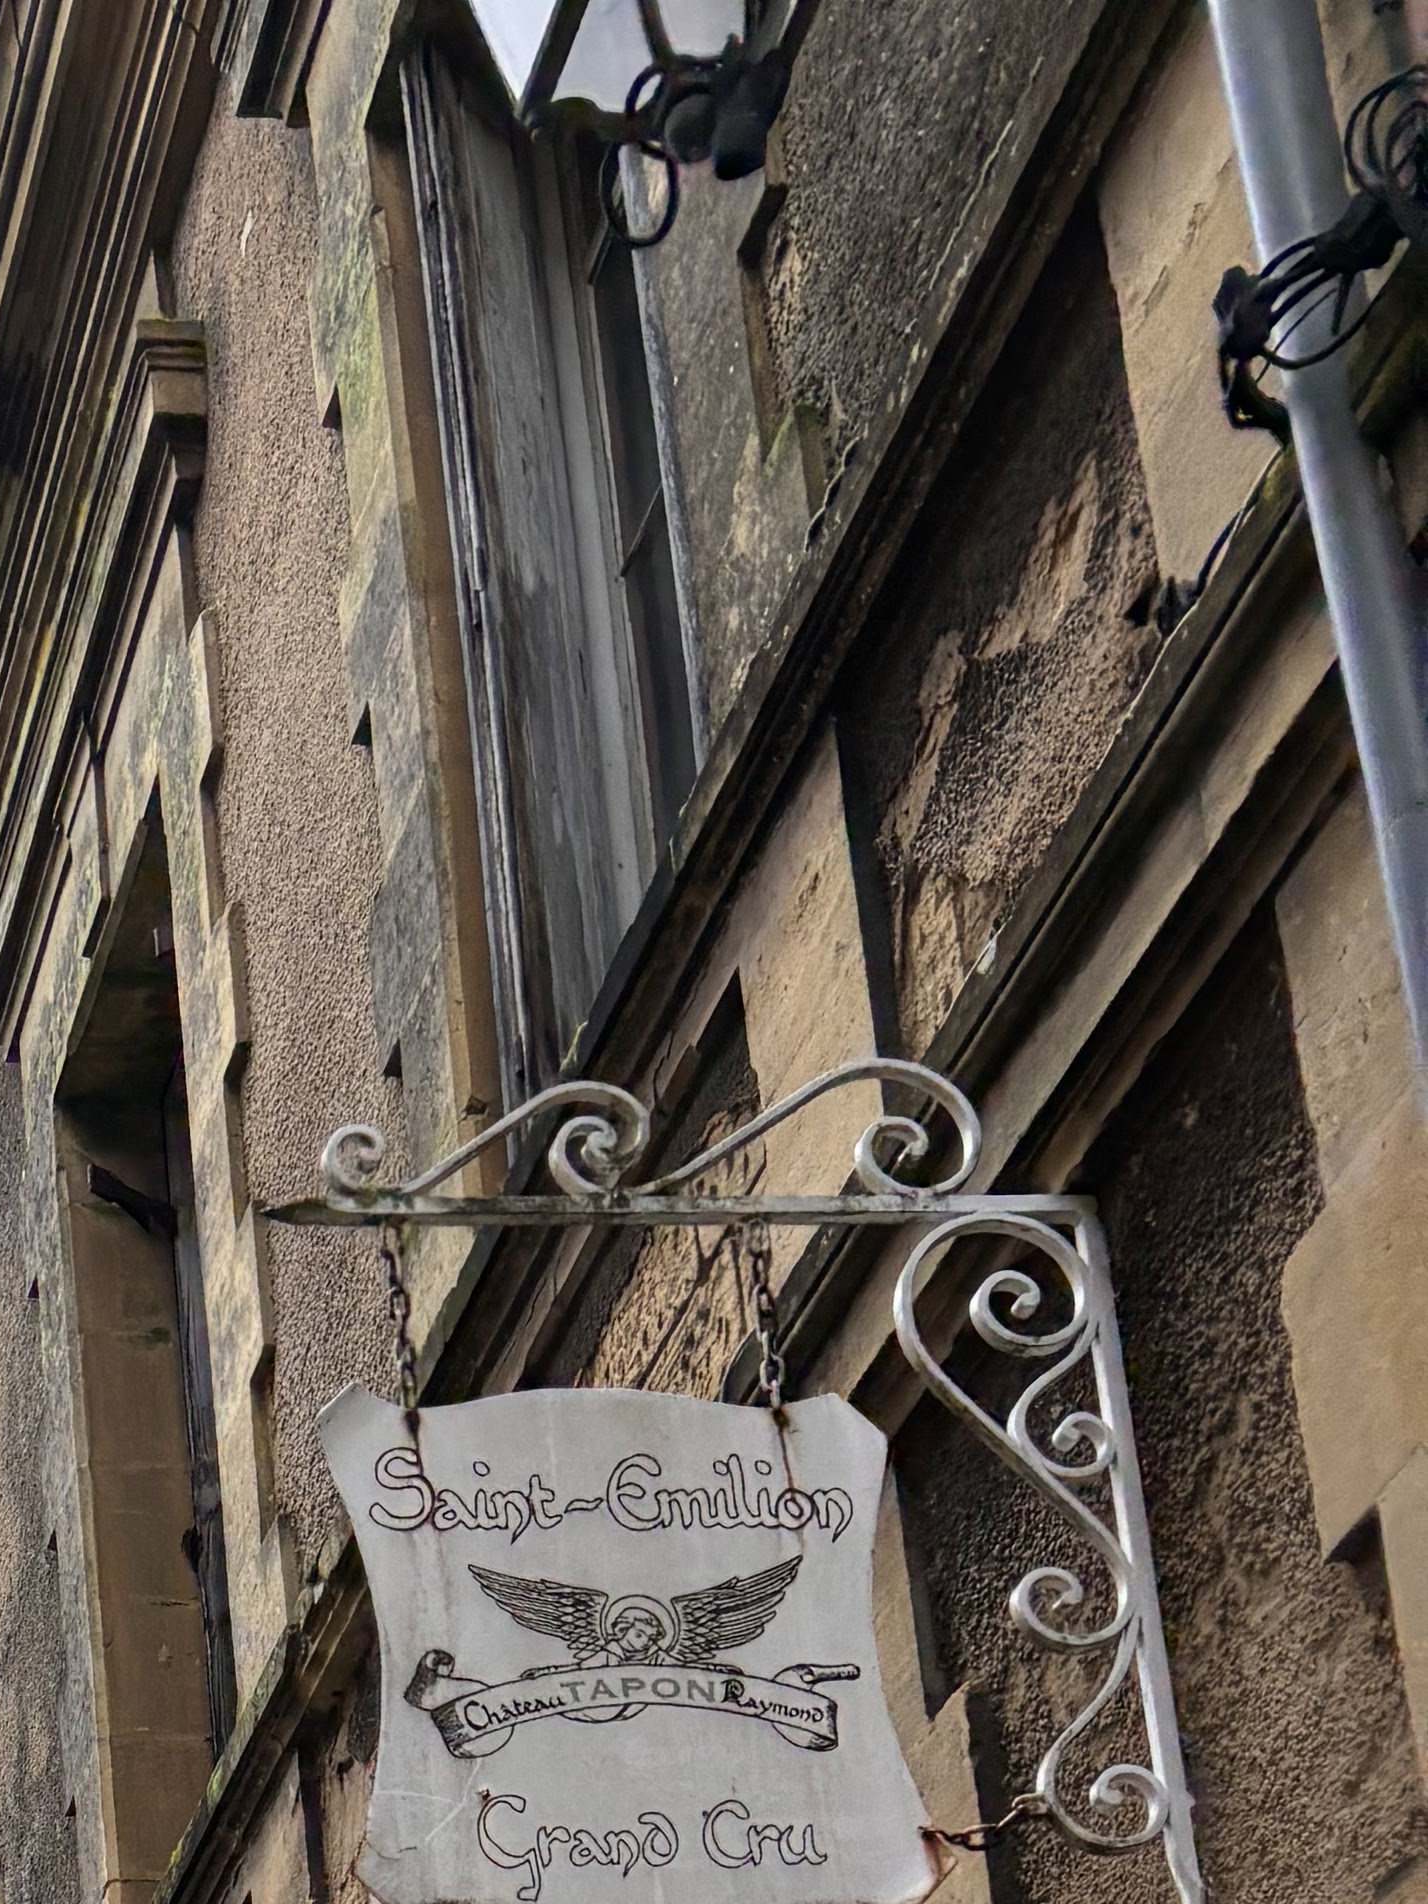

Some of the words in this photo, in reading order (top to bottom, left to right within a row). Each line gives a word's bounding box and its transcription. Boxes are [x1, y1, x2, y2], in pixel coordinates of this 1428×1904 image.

[463, 1694, 566, 1731] Château
[560, 1677, 715, 1703] TAPON
[721, 1678, 826, 1723] Raymond
[476, 1795, 679, 1902] Grand
[701, 1800, 829, 1870] Cru
